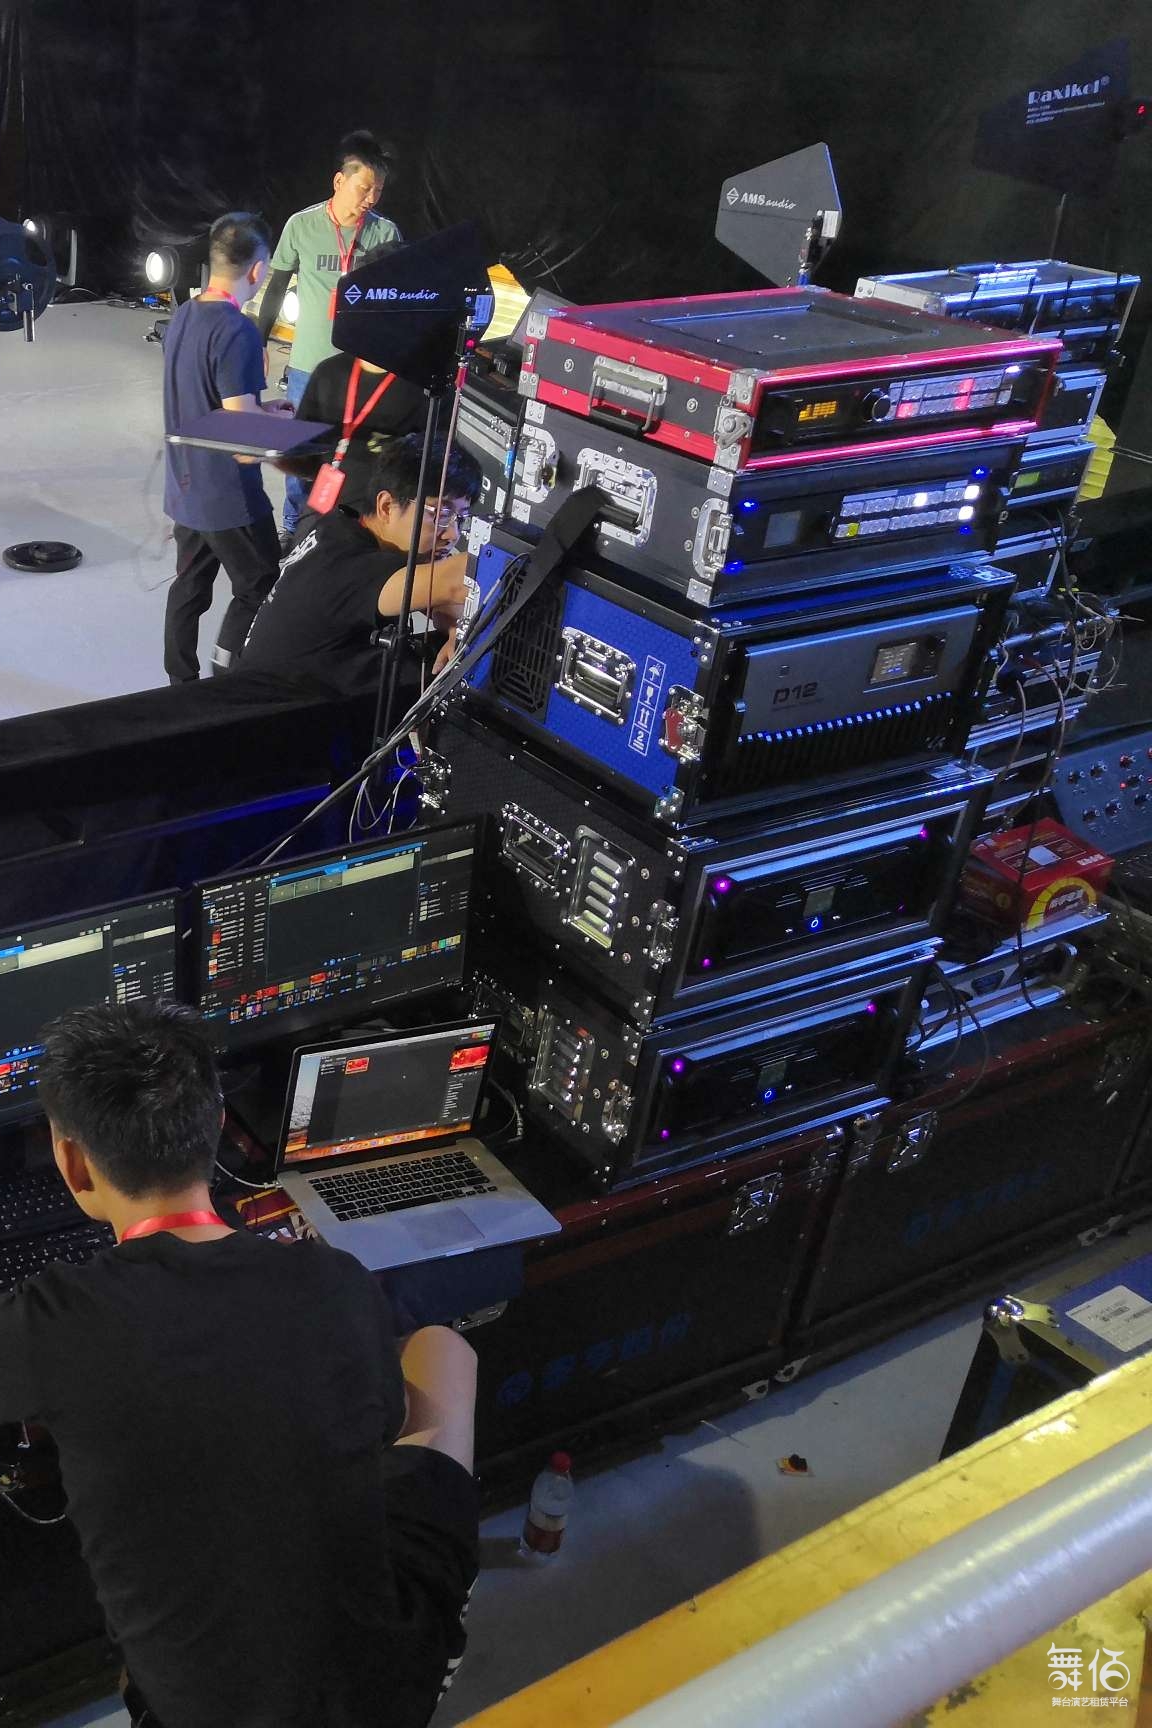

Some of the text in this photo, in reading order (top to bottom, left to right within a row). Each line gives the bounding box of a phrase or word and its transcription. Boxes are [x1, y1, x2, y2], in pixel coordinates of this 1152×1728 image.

[740, 192, 797, 210] AMS audio
[364, 287, 440, 301] AMS audio
